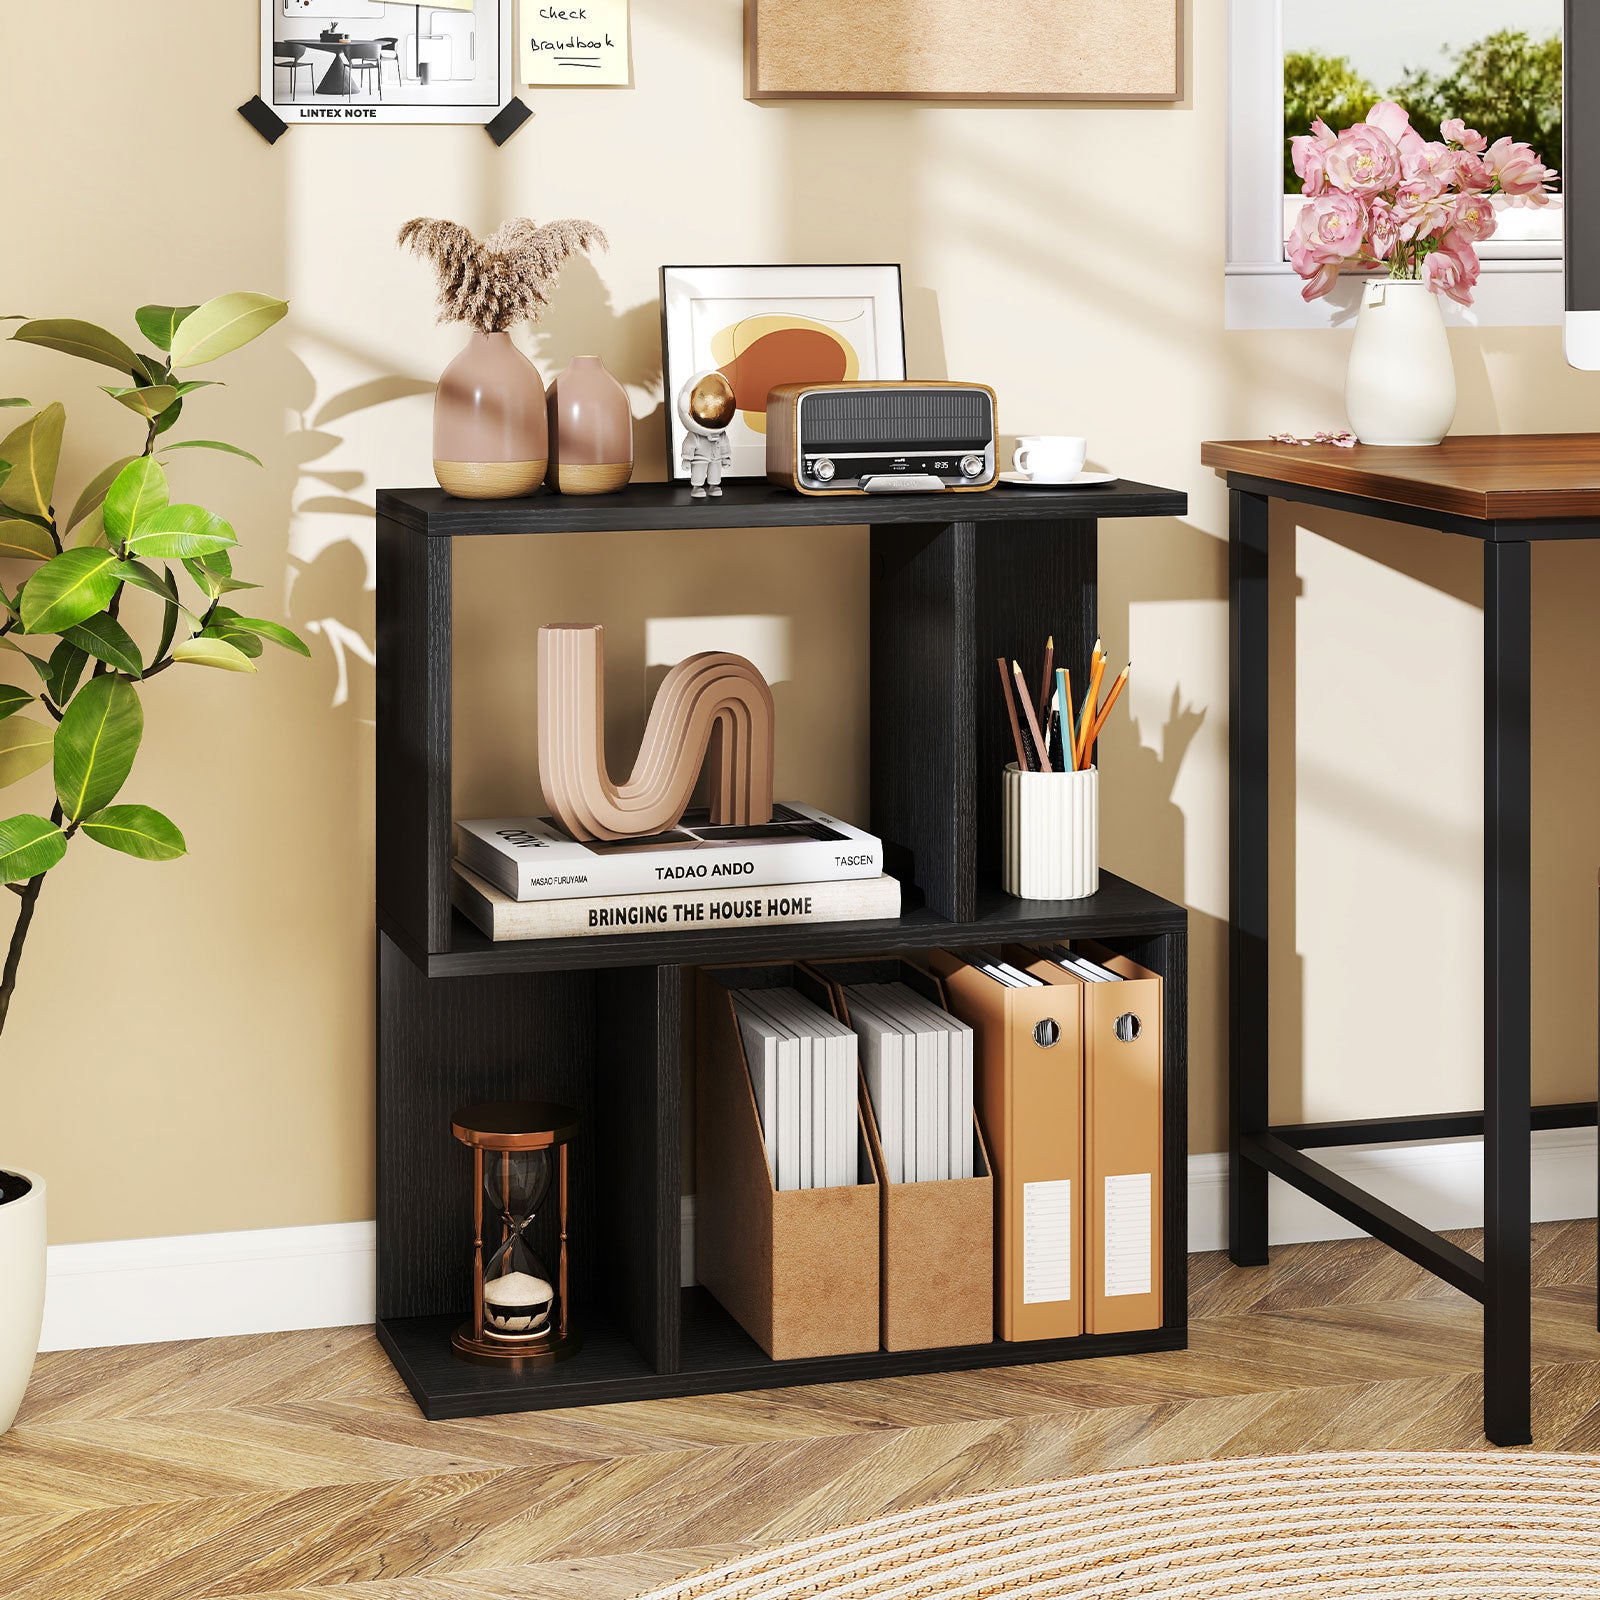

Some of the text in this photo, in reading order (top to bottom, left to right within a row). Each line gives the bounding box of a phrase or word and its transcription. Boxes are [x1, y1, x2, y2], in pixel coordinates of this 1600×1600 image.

[531, 33, 615, 52] Brandbook
[300, 109, 377, 118] LINTEX NOTE
[495, 829, 550, 848] ANDO
[655, 861, 755, 880] TADAO ANDO
[530, 875, 588, 887] MASAO FURUYAMA
[588, 897, 812, 927] BRINGING THE HOUSE HOME
